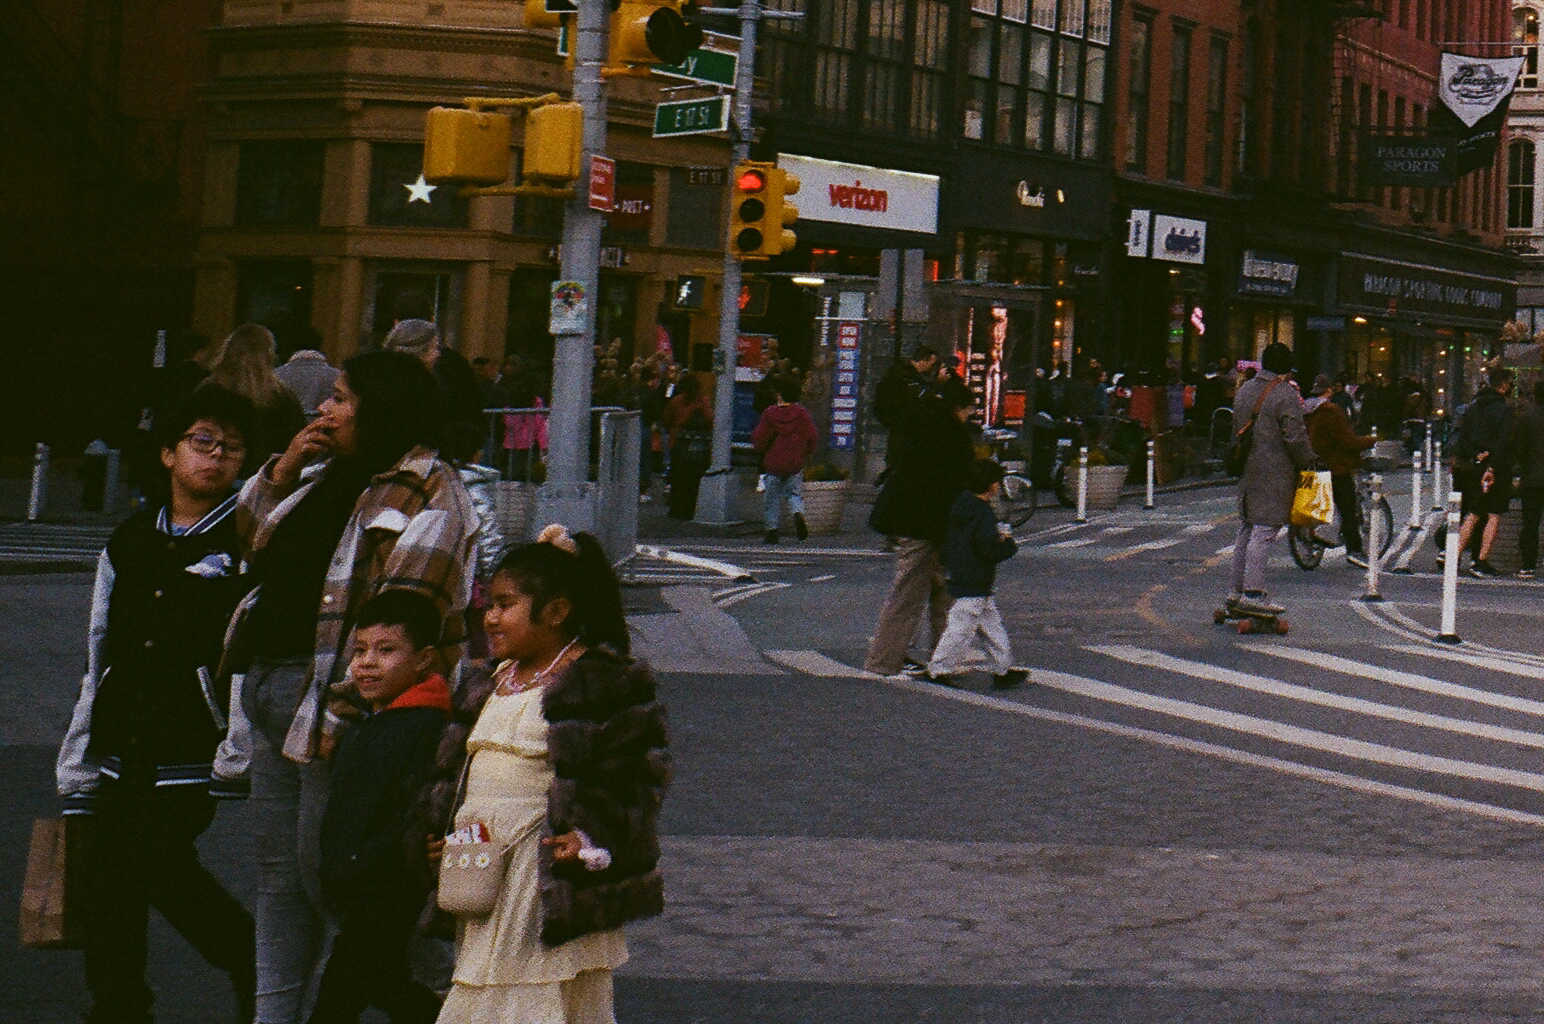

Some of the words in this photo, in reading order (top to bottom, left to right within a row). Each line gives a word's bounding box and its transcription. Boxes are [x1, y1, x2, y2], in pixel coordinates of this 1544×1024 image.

[675, 108, 682, 128] E
[1377, 146, 1448, 159] PARAGON
[1383, 160, 1440, 173] SPORTS
[829, 180, 888, 213] verizon
